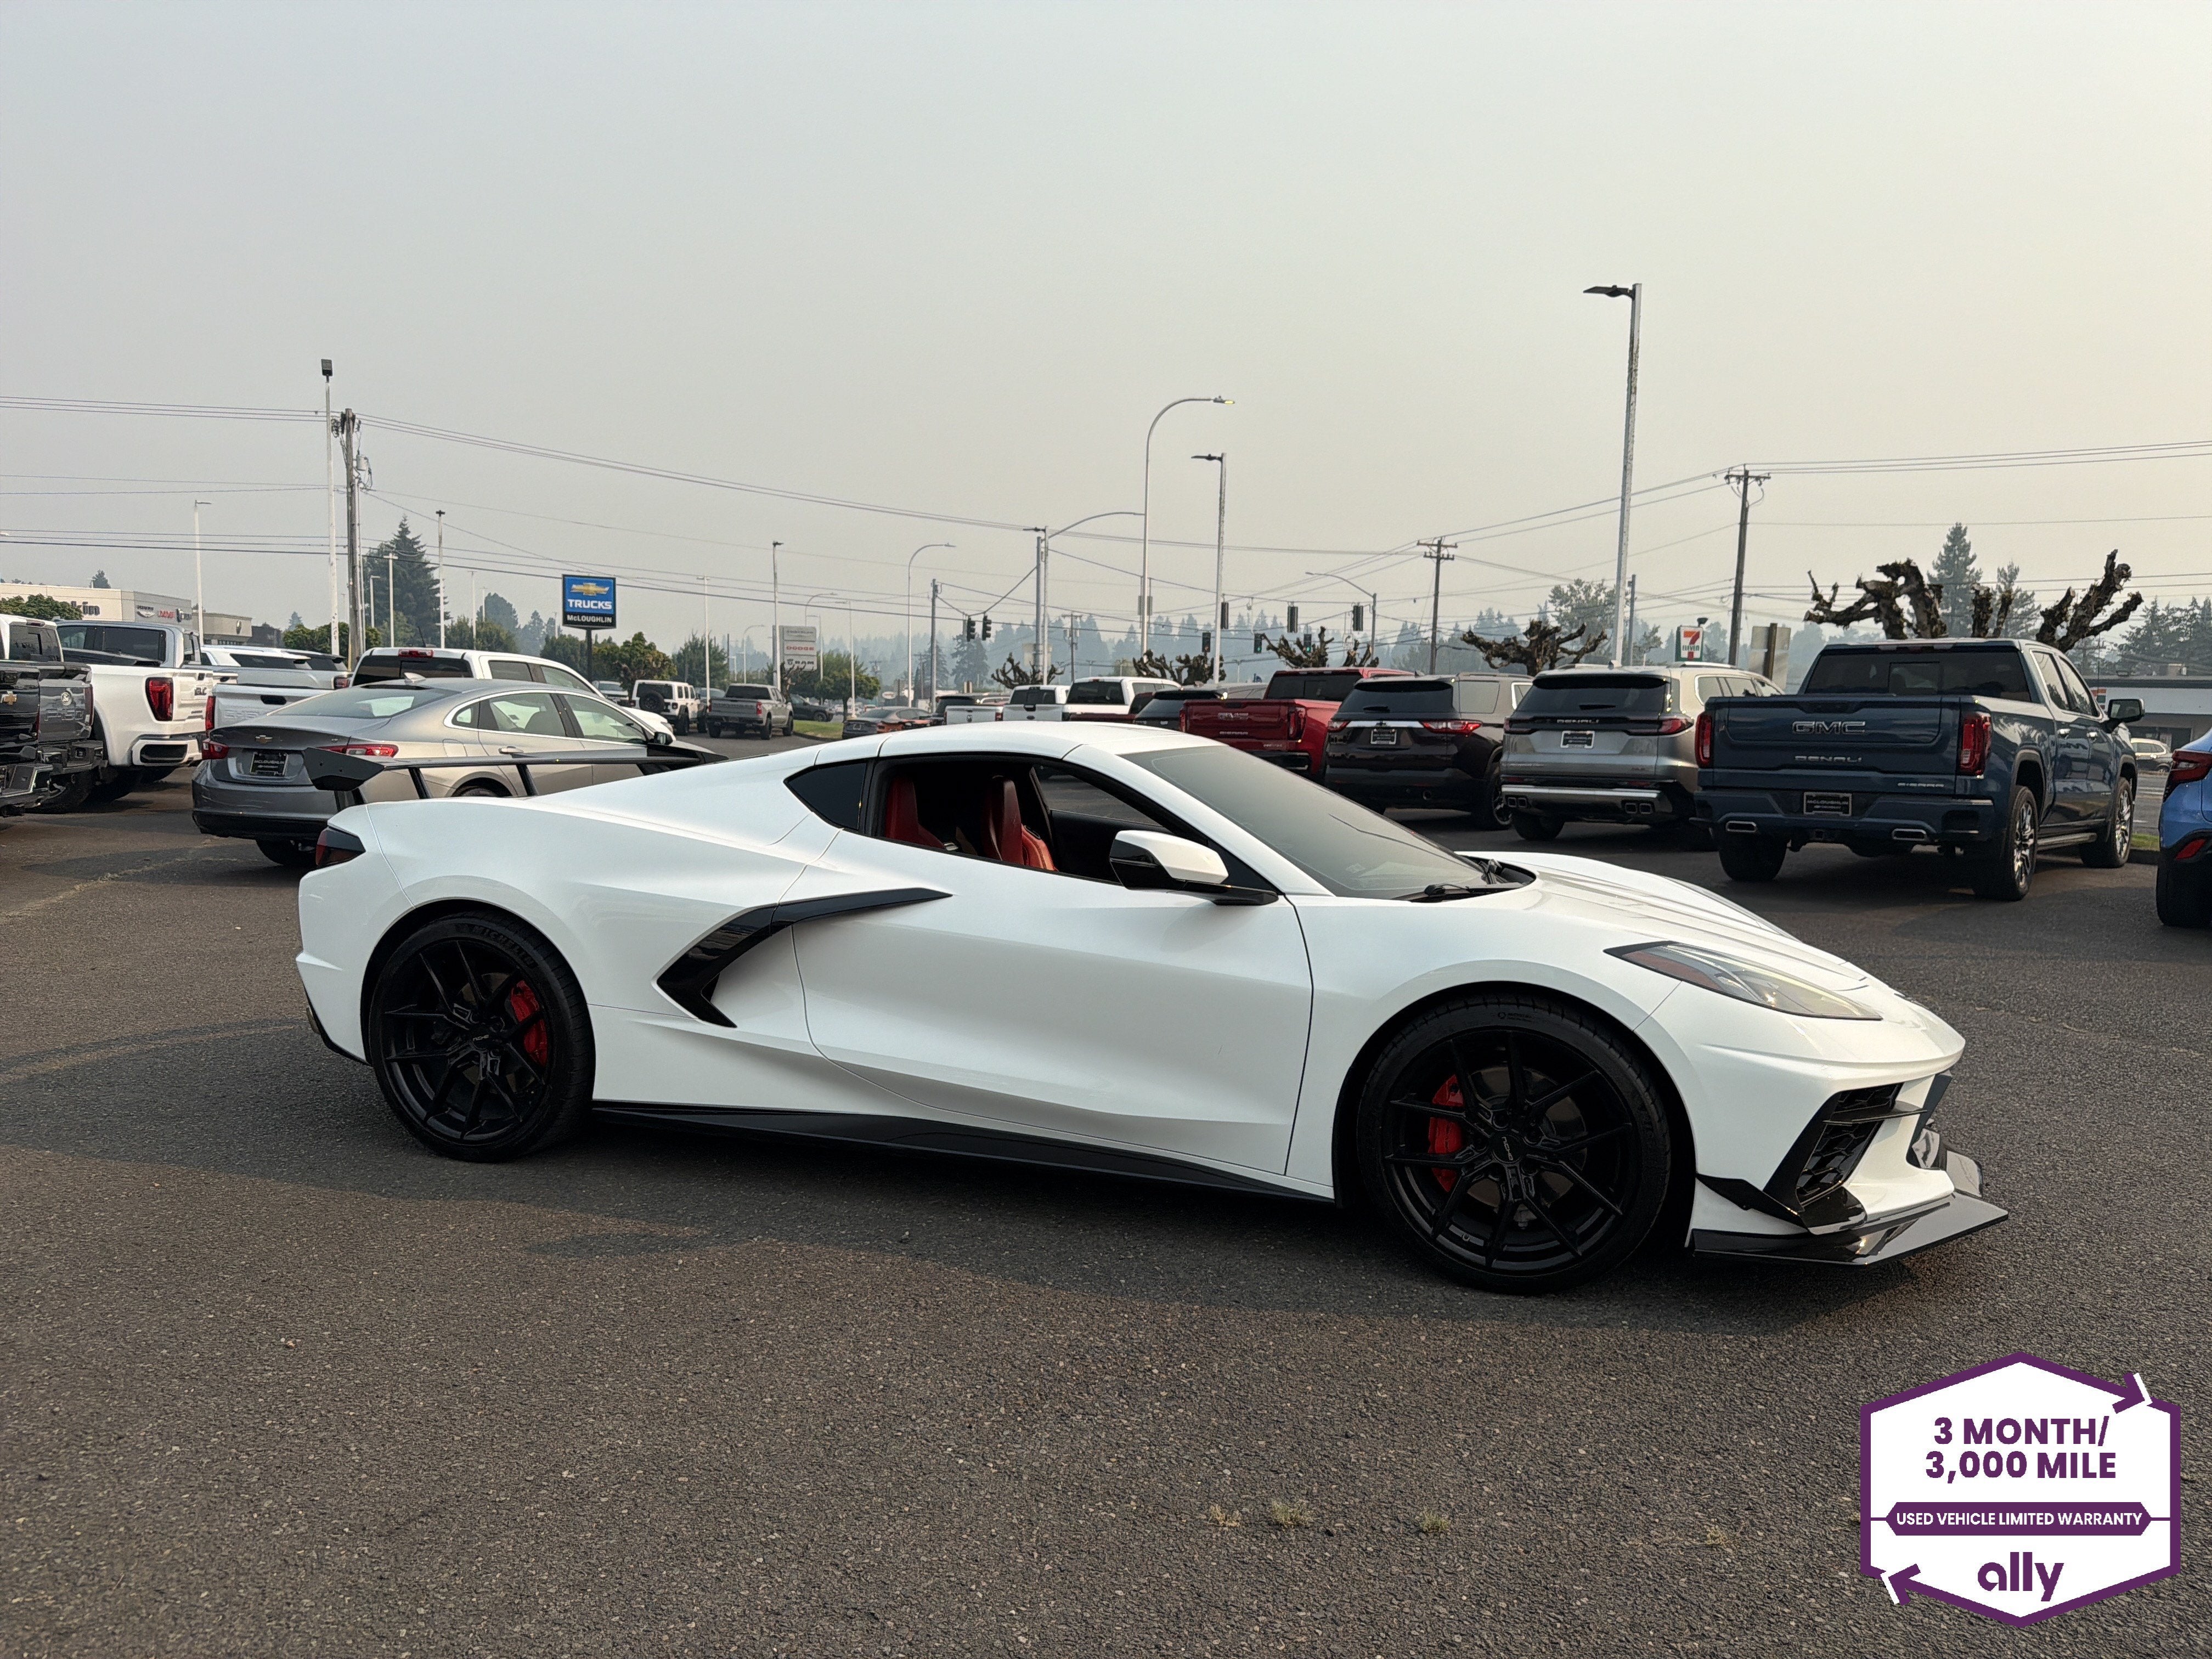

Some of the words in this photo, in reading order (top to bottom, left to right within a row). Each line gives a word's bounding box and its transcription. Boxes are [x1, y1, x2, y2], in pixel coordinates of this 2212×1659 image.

[567, 599, 612, 610] TRUCKS
[567, 614, 612, 623] McLOUGHLIN
[1792, 721, 1865, 734] GMC
